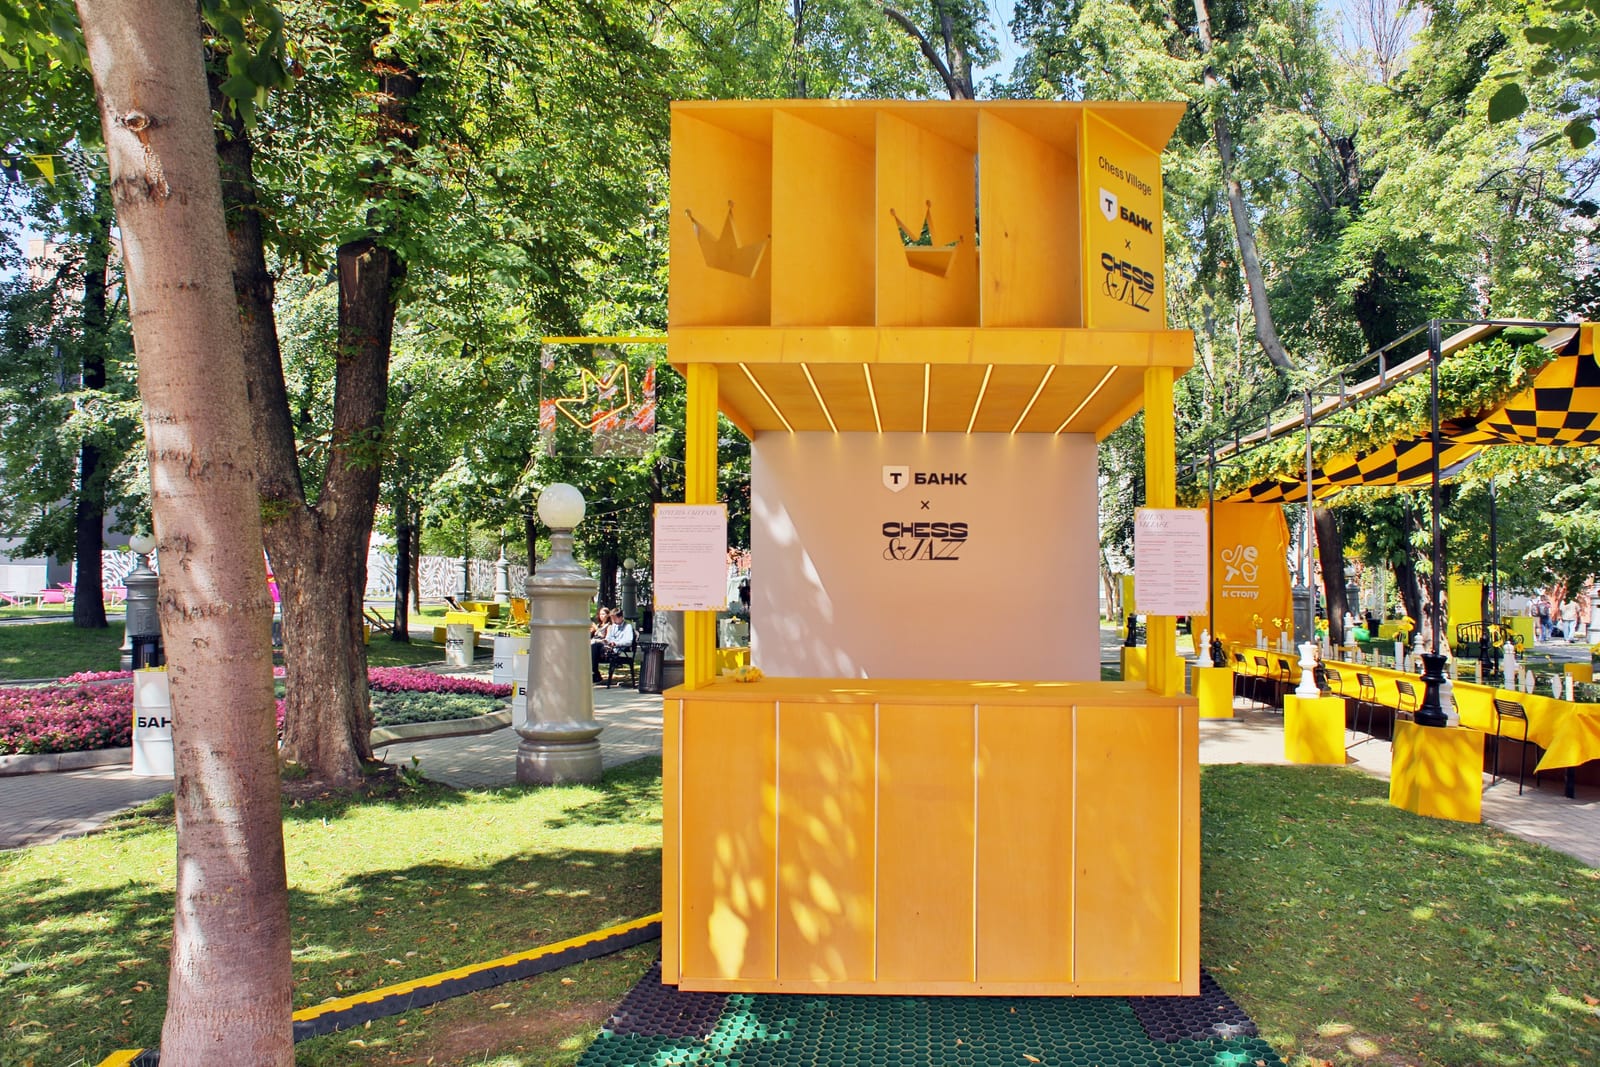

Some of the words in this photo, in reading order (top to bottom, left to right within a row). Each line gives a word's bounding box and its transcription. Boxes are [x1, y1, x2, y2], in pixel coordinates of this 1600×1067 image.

[1098, 156, 1124, 180] Chess
[1125, 170, 1152, 196] Village
[1120, 206, 1153, 234] БАНК
[1101, 252, 1154, 289] CHESS
[914, 472, 967, 485] БАНК
[882, 521, 968, 538] CHESS
